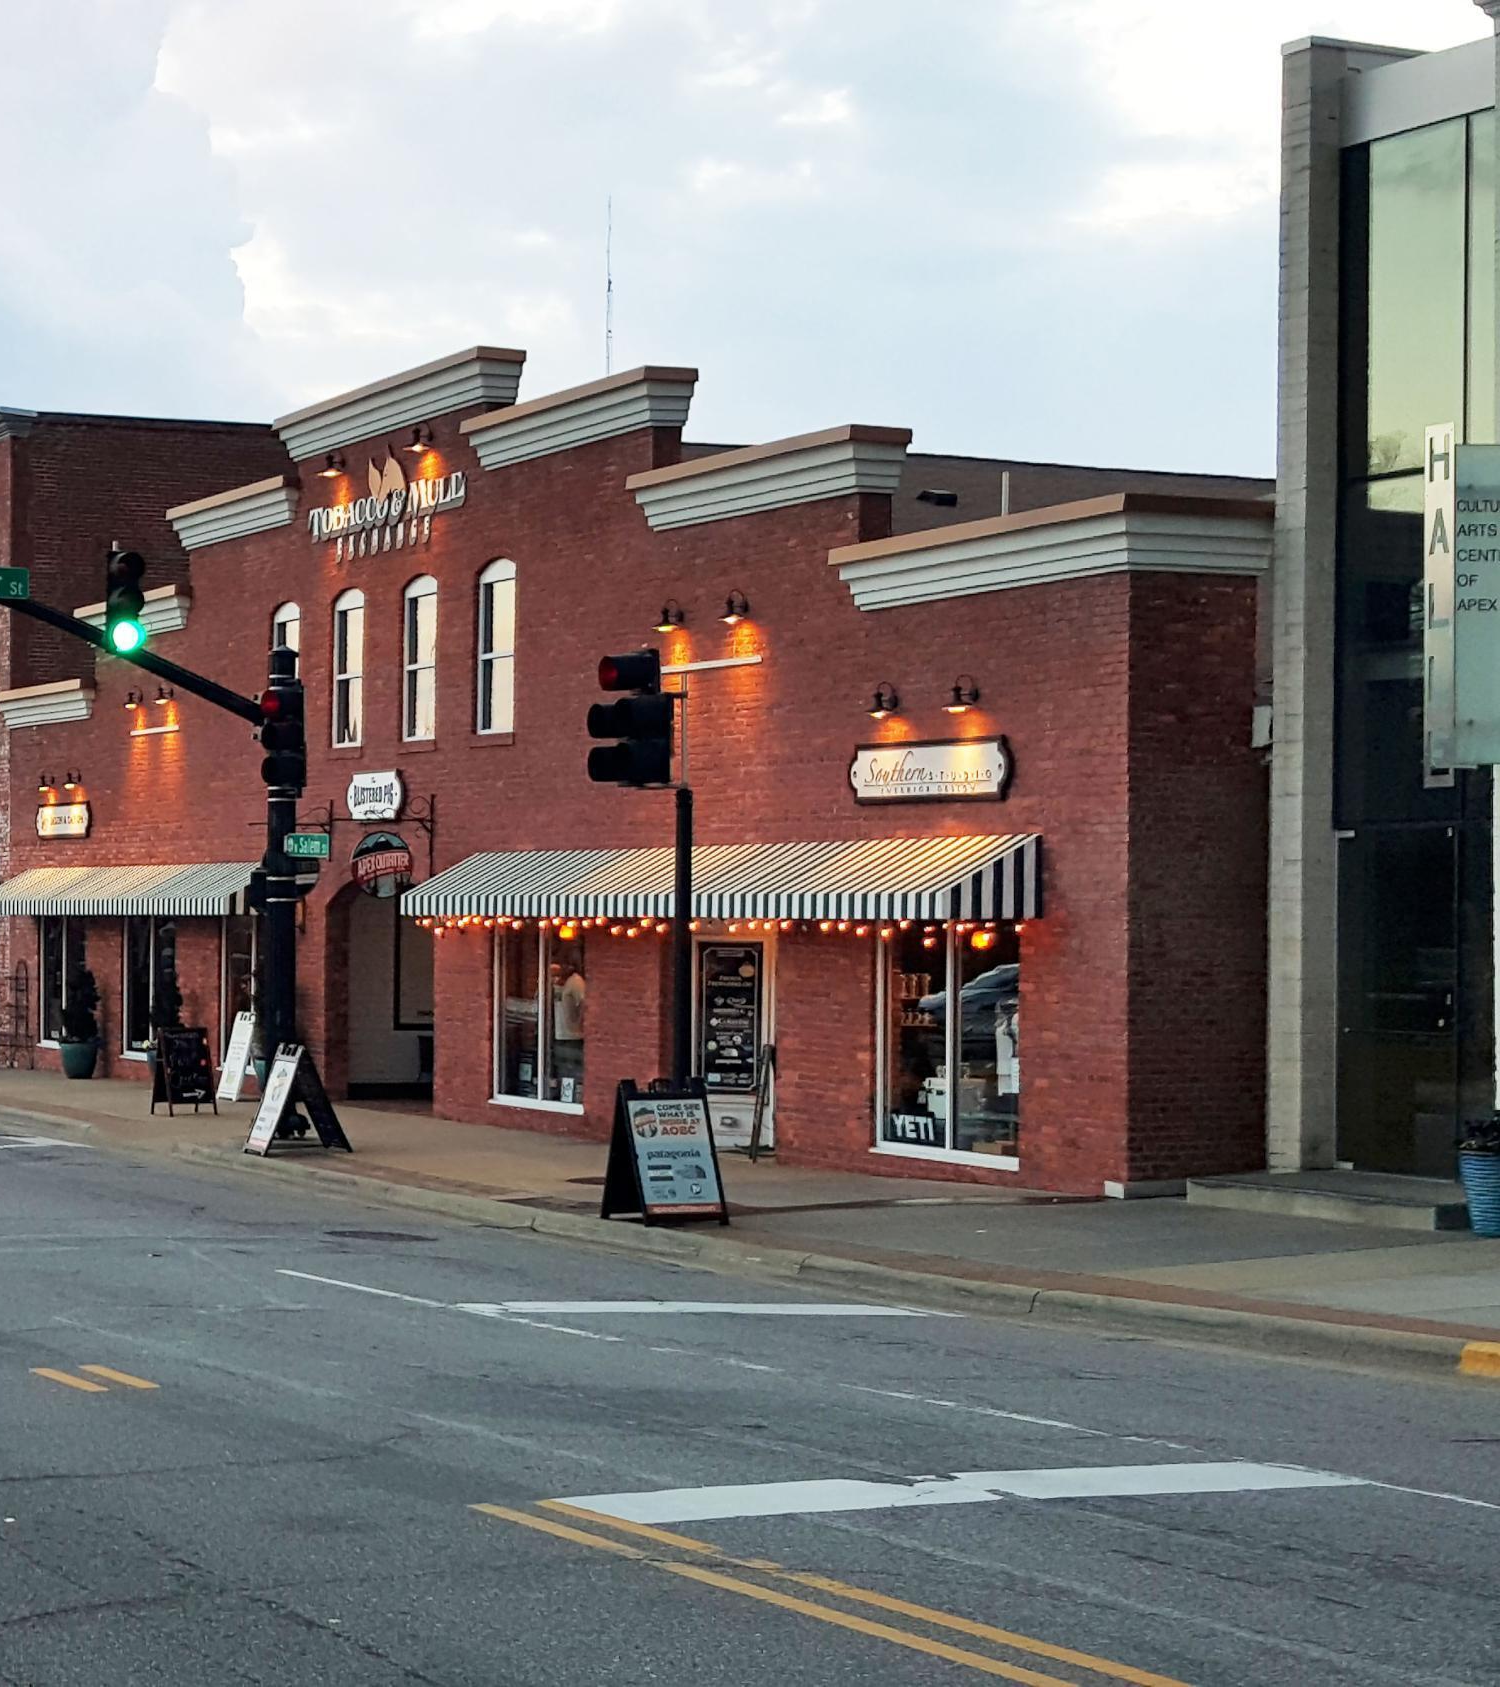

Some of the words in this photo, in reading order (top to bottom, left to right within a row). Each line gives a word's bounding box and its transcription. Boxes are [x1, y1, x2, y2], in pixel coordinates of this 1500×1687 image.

[309, 496, 388, 539] TOBACCO
[390, 488, 407, 519] &
[406, 471, 467, 515] MULE
[1457, 524, 1498, 537] ARTS
[1457, 549, 1500, 562] CENT
[1457, 574, 1479, 588] OF
[9, 581, 23, 596] St
[1457, 599, 1498, 612] APEX
[864, 750, 928, 784] Southern
[299, 837, 321, 854] Salem
[658, 1110, 684, 1118] WHAT
[892, 1114, 934, 1141] YETI
[647, 1149, 701, 1160] patagonia
